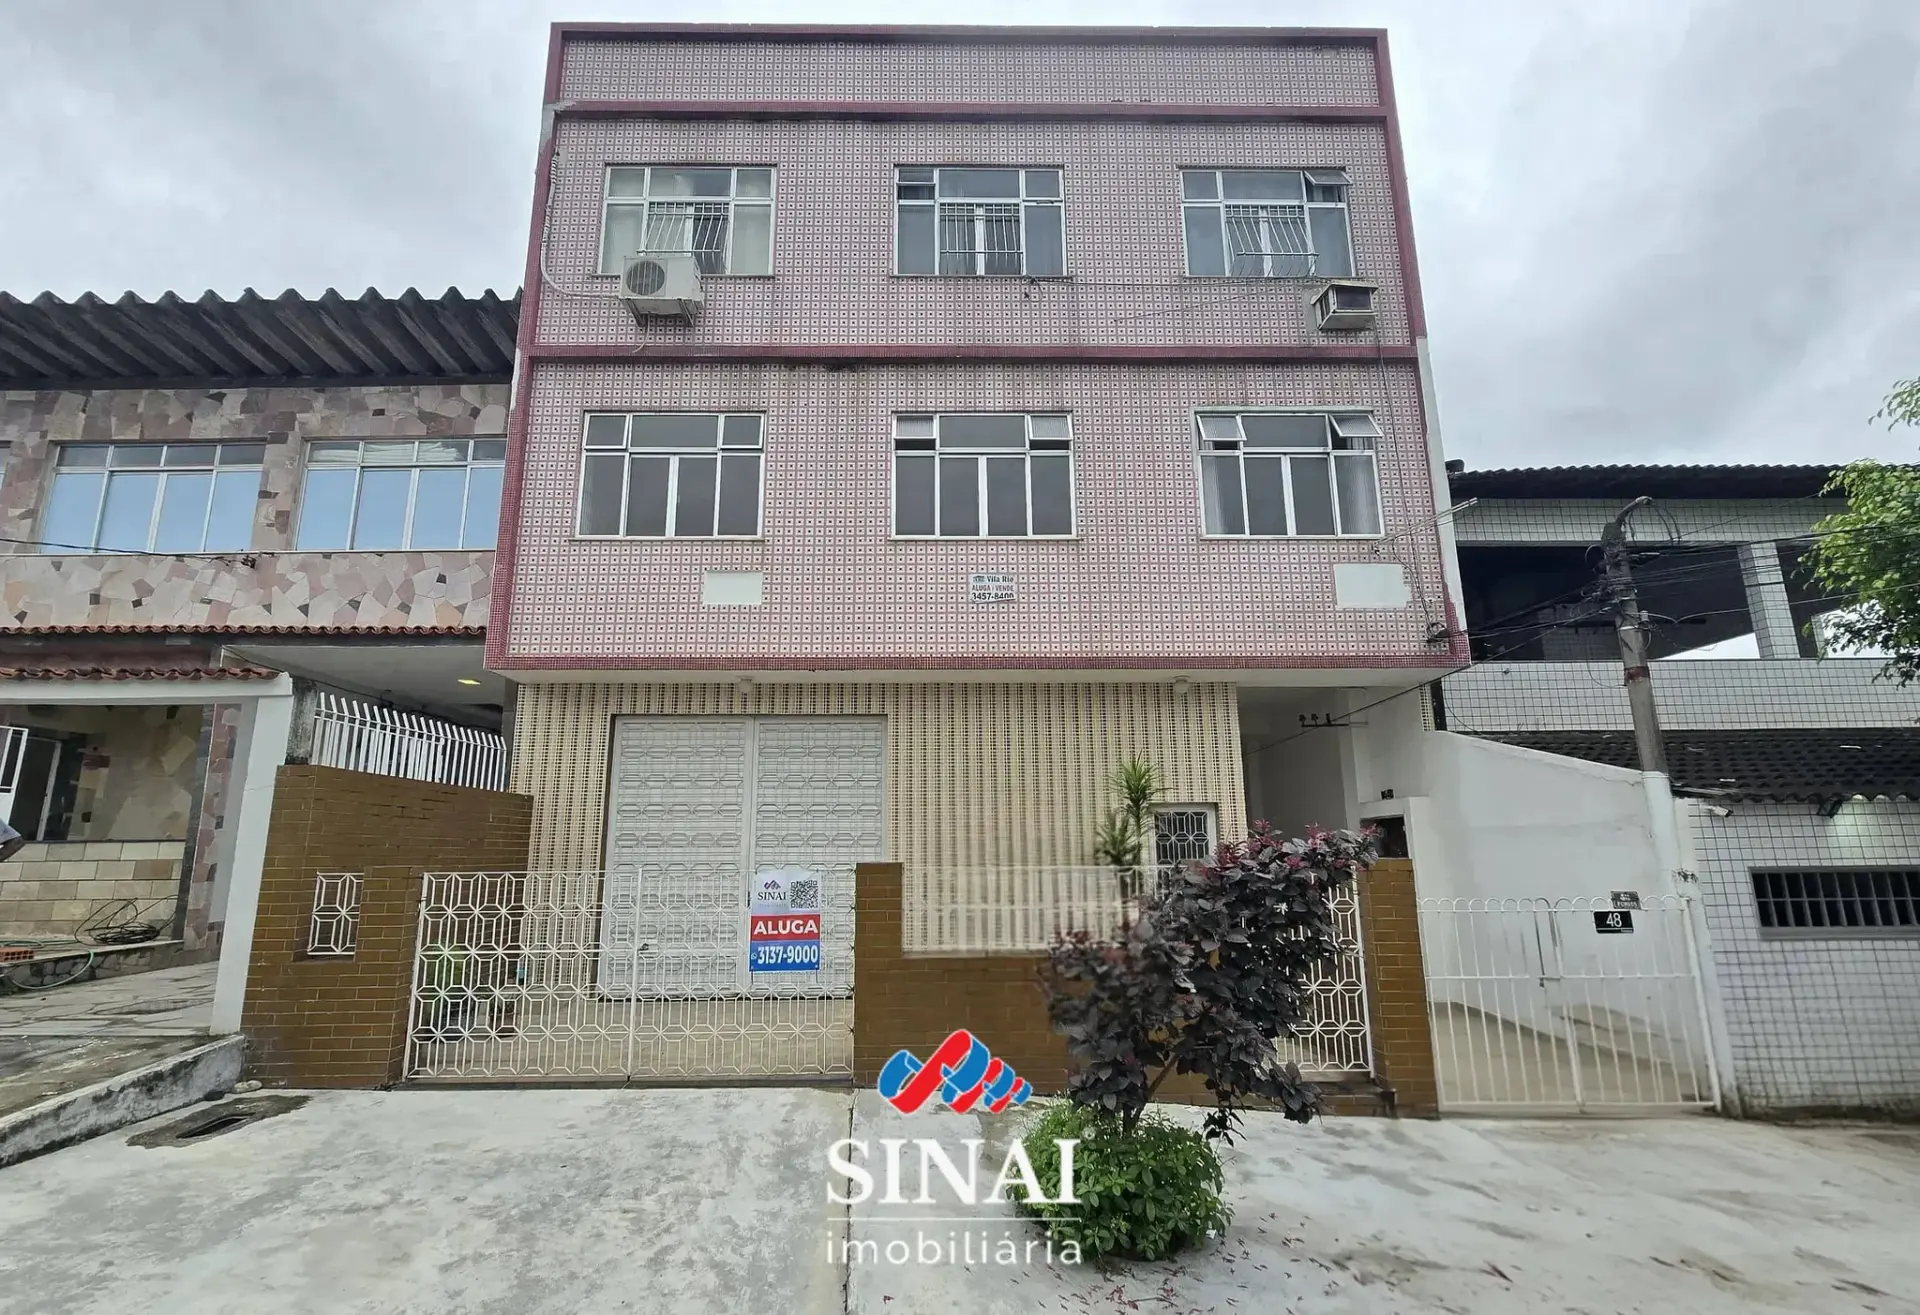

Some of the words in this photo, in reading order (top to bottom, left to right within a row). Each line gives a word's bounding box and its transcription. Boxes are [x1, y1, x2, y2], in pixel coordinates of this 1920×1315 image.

[757, 892, 786, 901] SINAI
[1606, 912, 1622, 927] 48
[753, 920, 819, 935] ALUGA
[757, 945, 818, 964] 3137-9000
